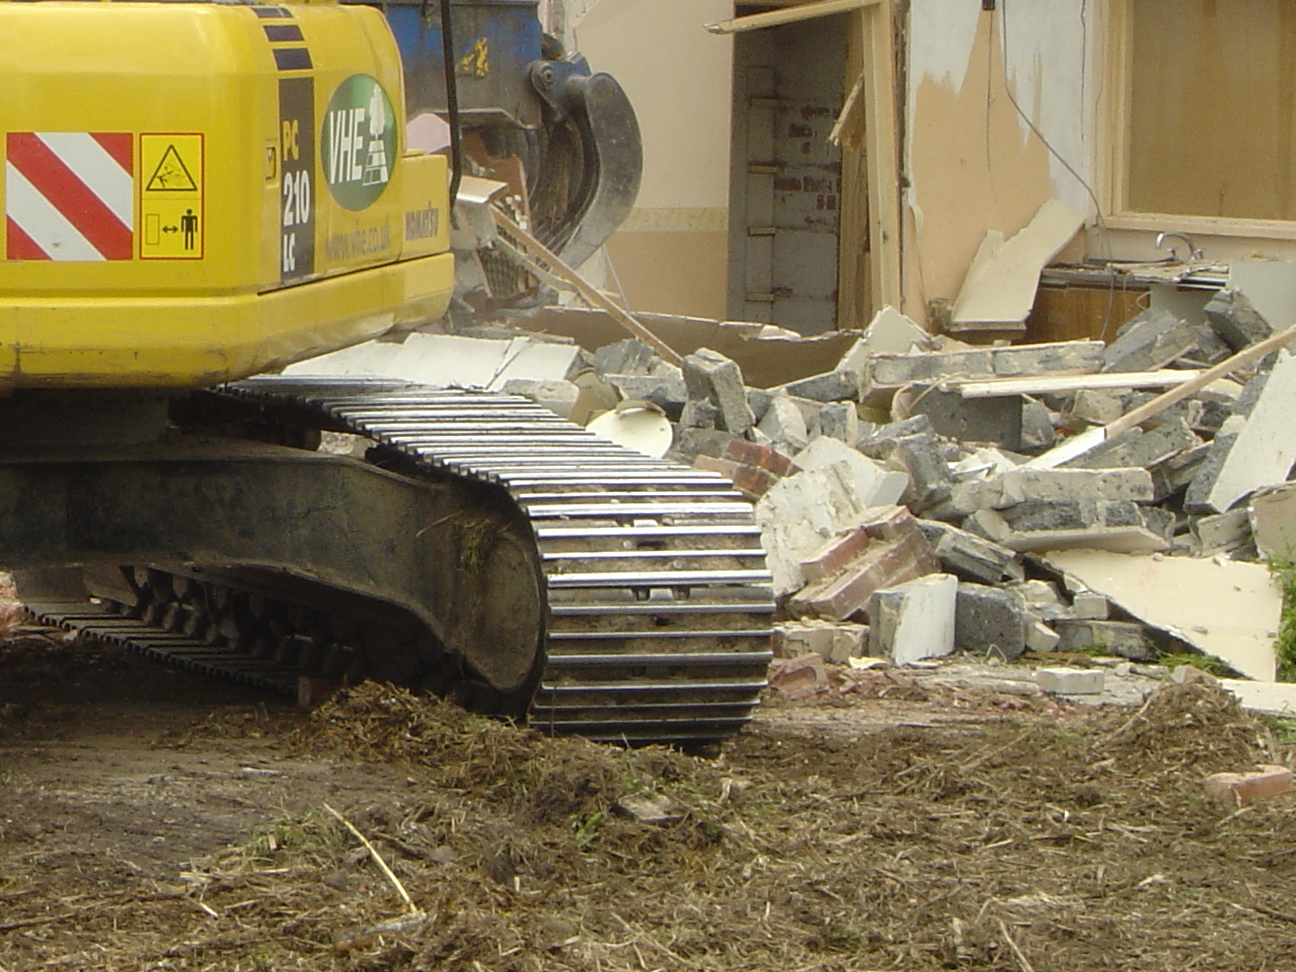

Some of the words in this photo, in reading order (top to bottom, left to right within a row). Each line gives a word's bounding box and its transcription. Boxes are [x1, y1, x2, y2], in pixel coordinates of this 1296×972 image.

[282, 119, 300, 162] PC
[330, 107, 365, 185] VHE
[283, 170, 311, 227] 210
[283, 232, 296, 272] LC
